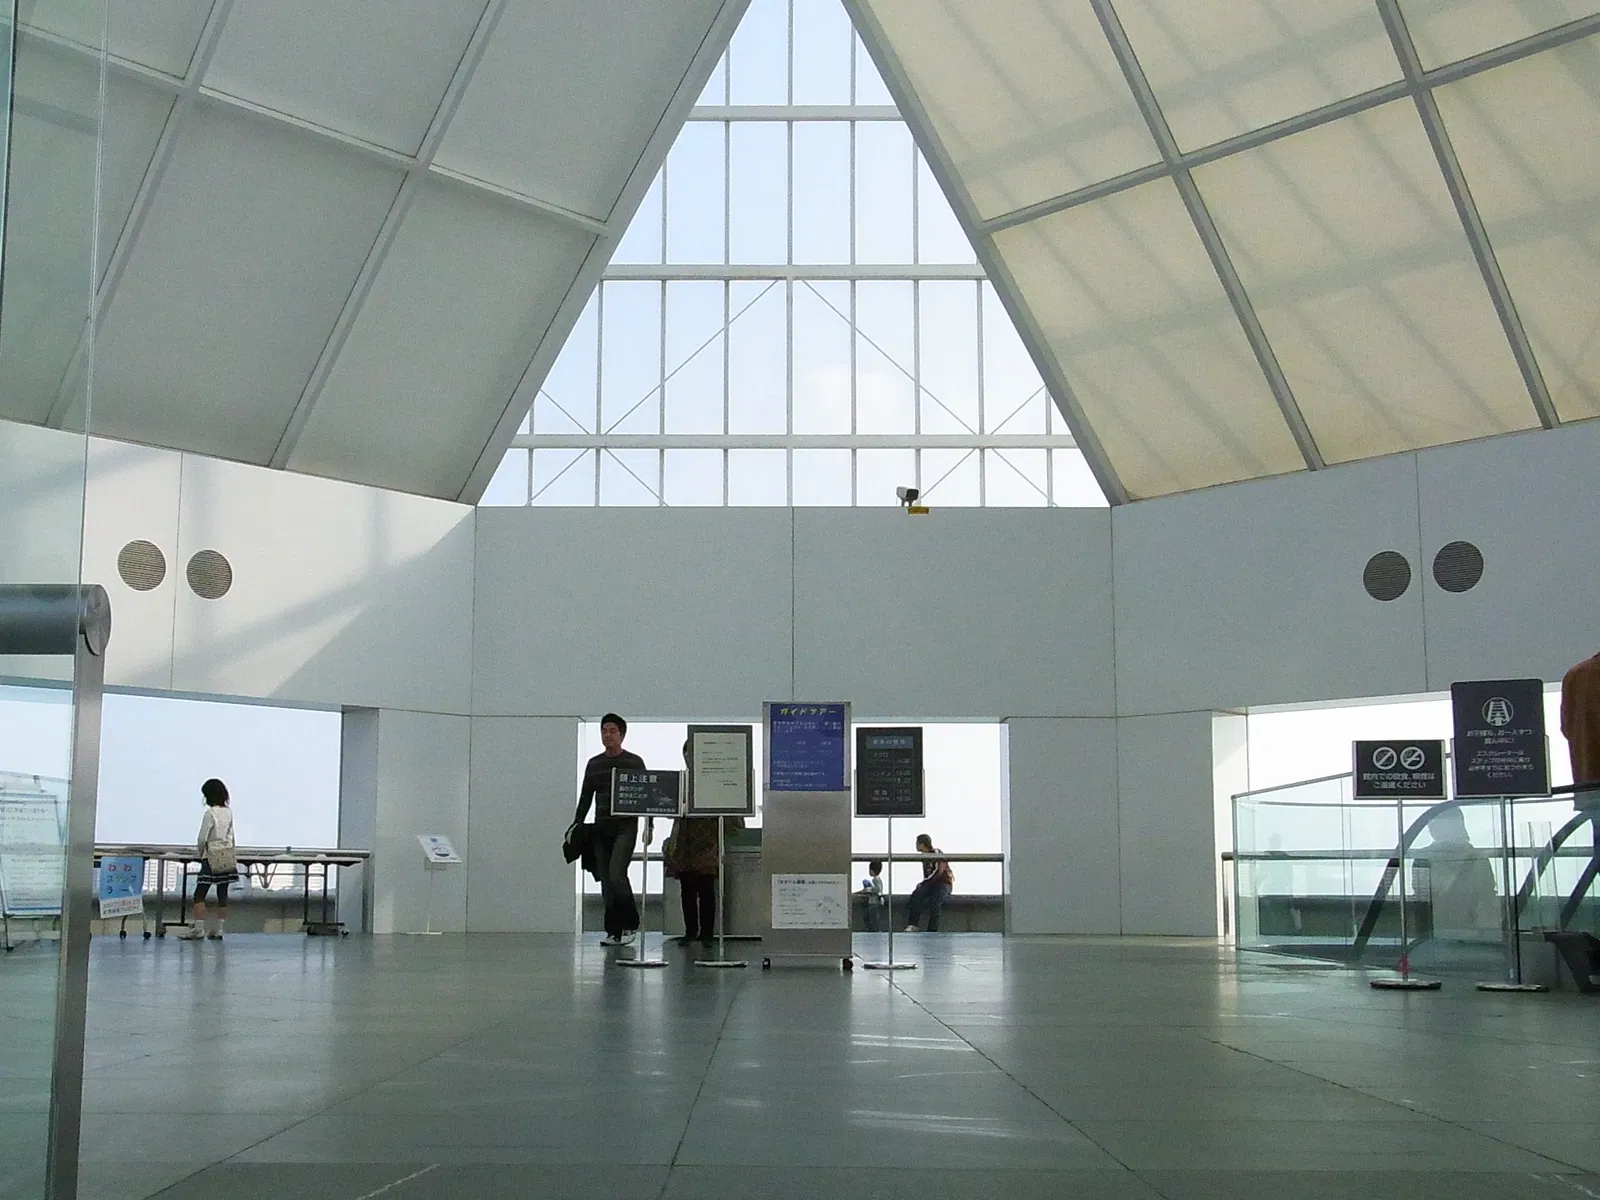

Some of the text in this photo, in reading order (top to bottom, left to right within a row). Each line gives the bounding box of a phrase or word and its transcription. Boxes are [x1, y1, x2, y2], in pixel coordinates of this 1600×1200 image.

[780, 707, 837, 716] ガイドツアー
[619, 773, 658, 783] 頭上注意
[1373, 781, 1426, 789] ご遠慮ください
